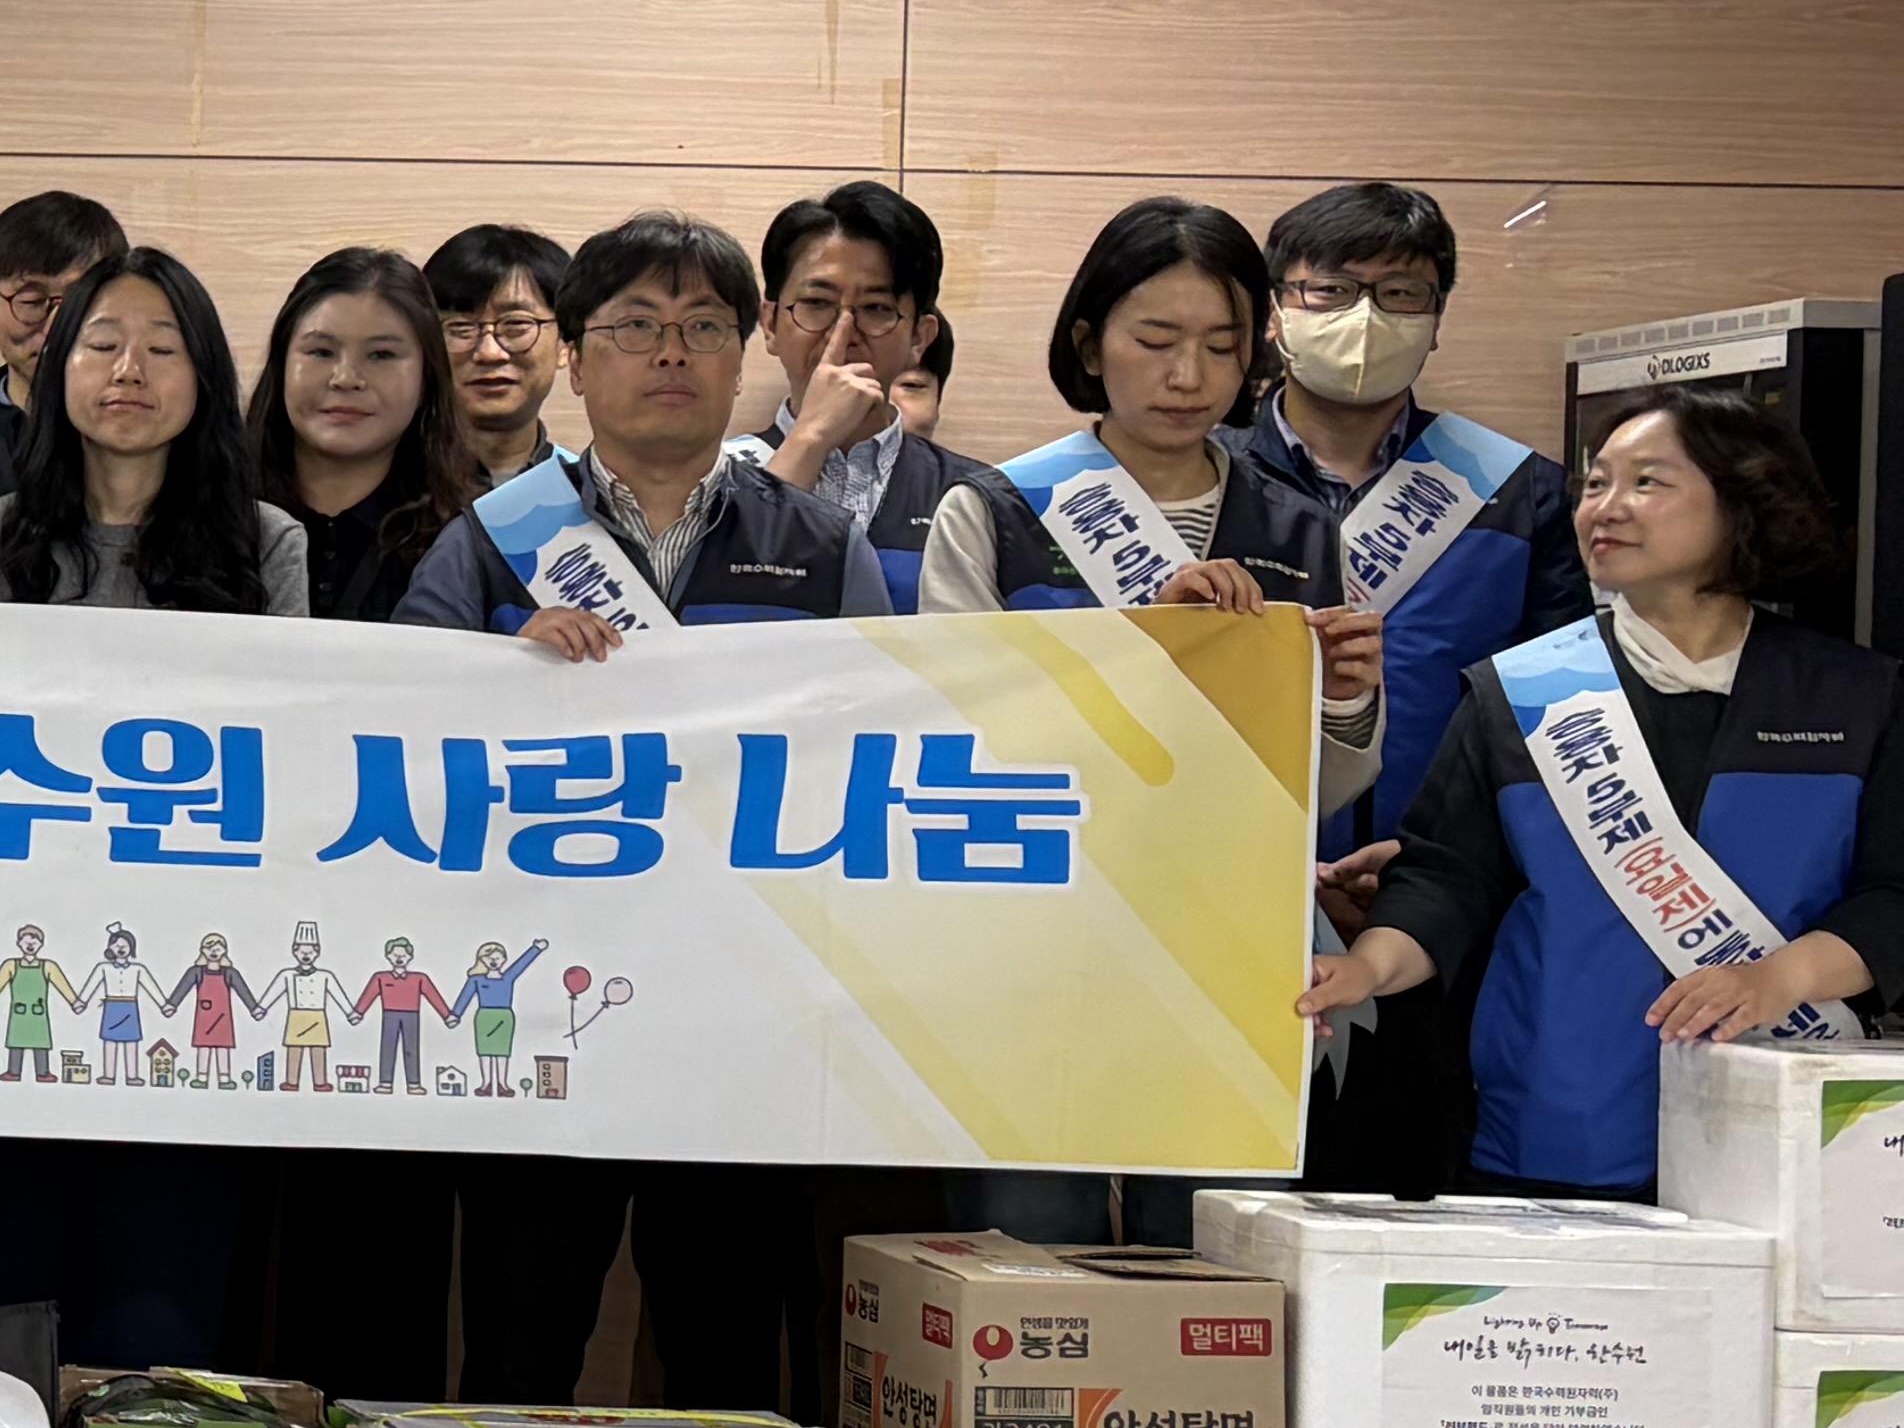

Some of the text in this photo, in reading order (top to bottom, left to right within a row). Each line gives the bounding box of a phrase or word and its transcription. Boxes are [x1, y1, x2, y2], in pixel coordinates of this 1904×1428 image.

[316, 730, 683, 879] 사랑
[728, 732, 1083, 886] 나눔
[1586, 772, 1654, 855] 5부제
[1019, 1330, 1090, 1360] 농심
[1188, 1322, 1264, 1352] 멀티팩
